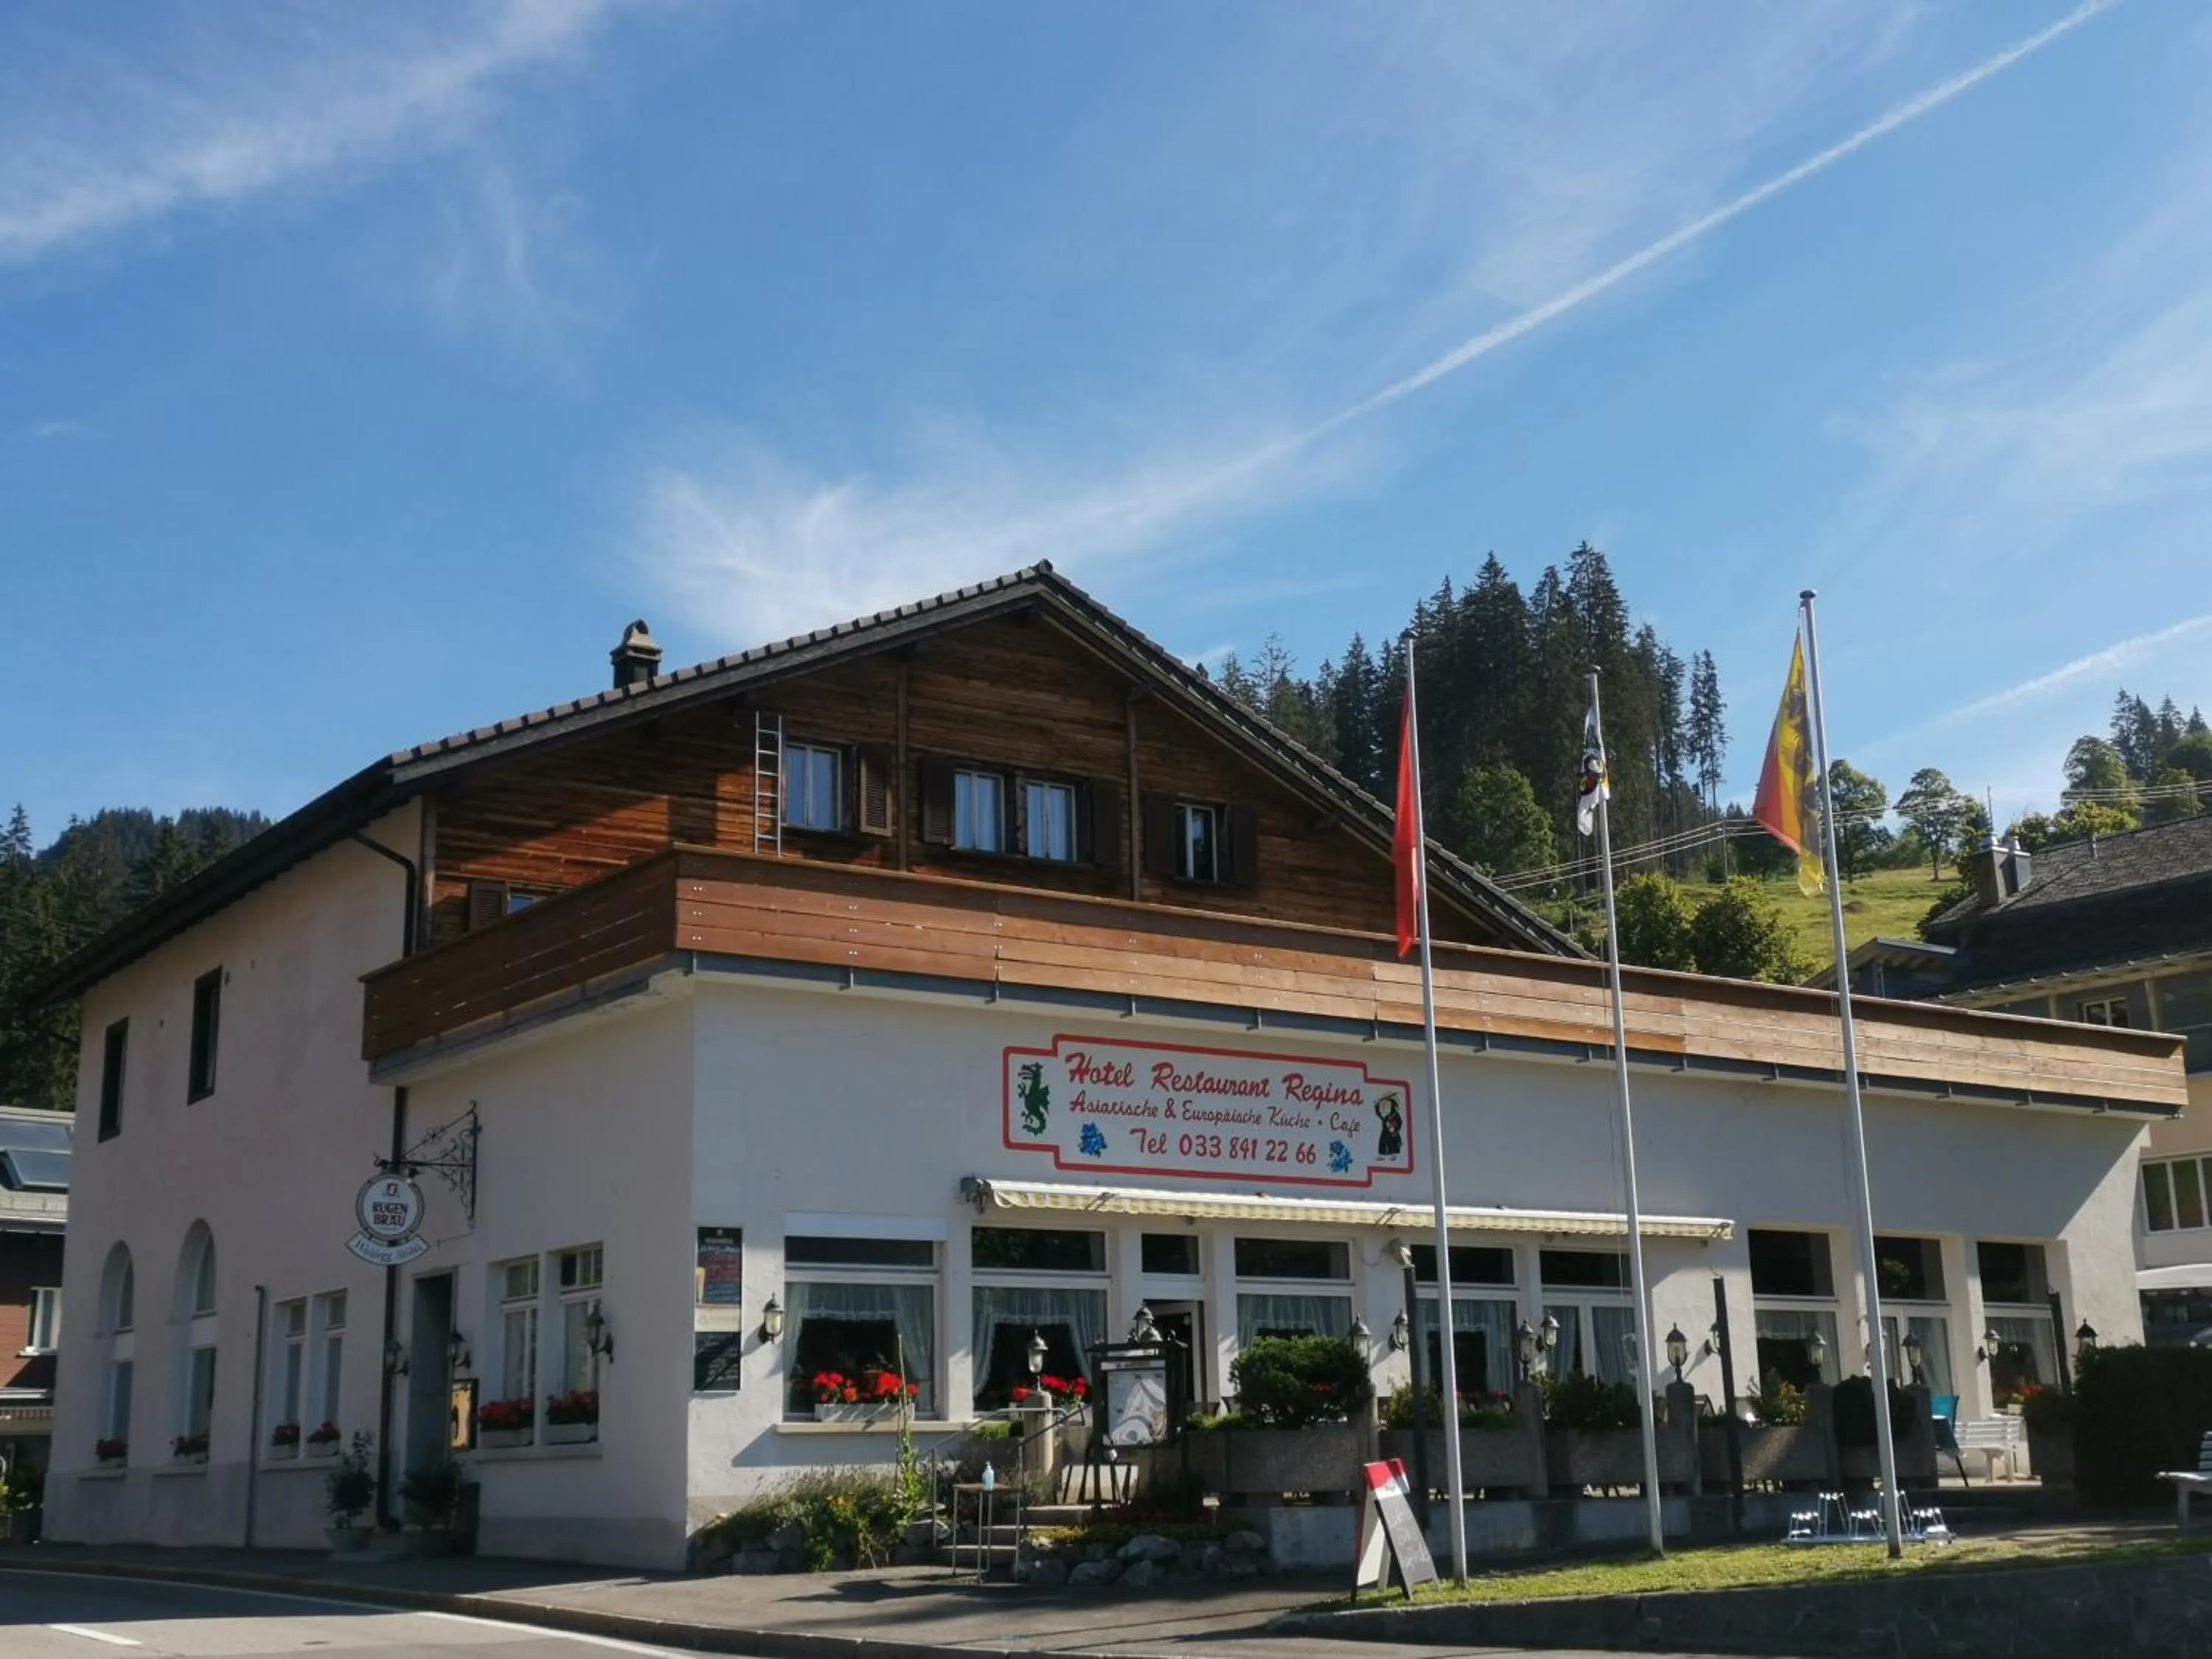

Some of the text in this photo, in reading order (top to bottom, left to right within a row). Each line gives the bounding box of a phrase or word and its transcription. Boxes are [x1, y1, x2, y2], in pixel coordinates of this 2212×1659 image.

[1065, 1051, 1364, 1110] Hotel Restaurant Regina
[1069, 1089, 1158, 1118] Asiatische
[1164, 1097, 1177, 1119] &
[1182, 1099, 1262, 1127] Europäische
[1129, 1127, 1317, 1165] Tel 033 841 22 66
[373, 1201, 408, 1214] RUGEN
